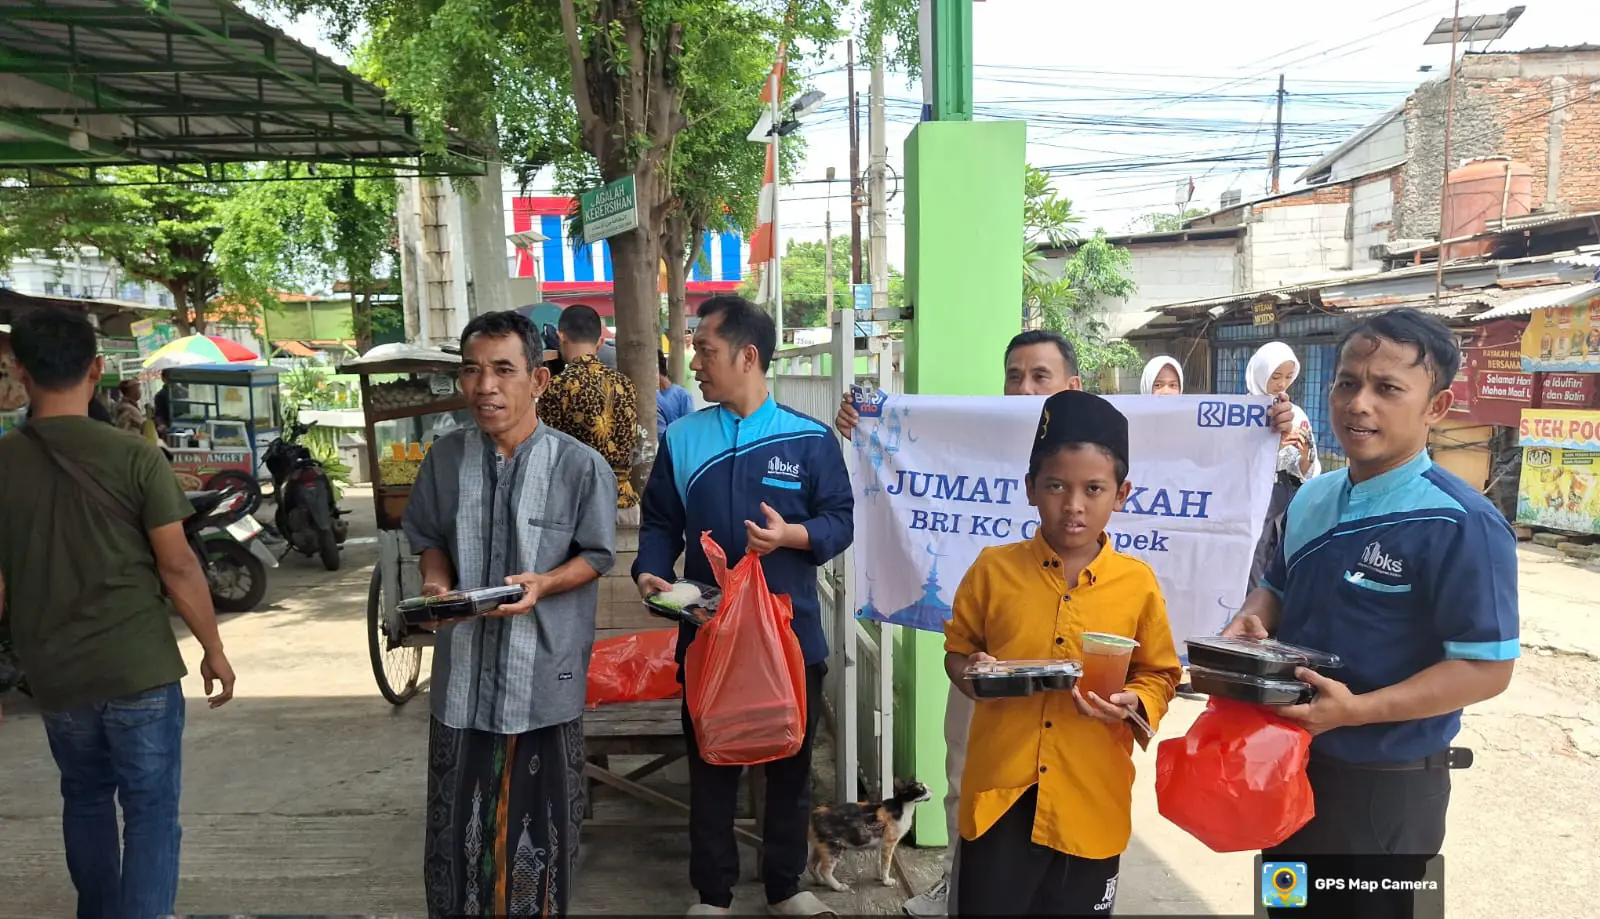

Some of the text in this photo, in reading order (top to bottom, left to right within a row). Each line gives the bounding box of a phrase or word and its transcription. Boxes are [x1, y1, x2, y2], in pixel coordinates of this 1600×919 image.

[585, 195, 632, 222] KEBERSIHAN
[1486, 374, 1516, 385] Selamat
[1481, 385, 1507, 396] Mohon
[1507, 387, 1526, 398] Maaf
[1546, 390, 1562, 400] dan
[1564, 390, 1586, 401] Batin
[1534, 418, 1564, 438] TEH
[173, 453, 202, 464] ILOK
[886, 469, 1213, 518] JUMAT KAH
[908, 509, 963, 534] BRI
[968, 515, 1013, 539] KC
[1373, 553, 1404, 574] bks
